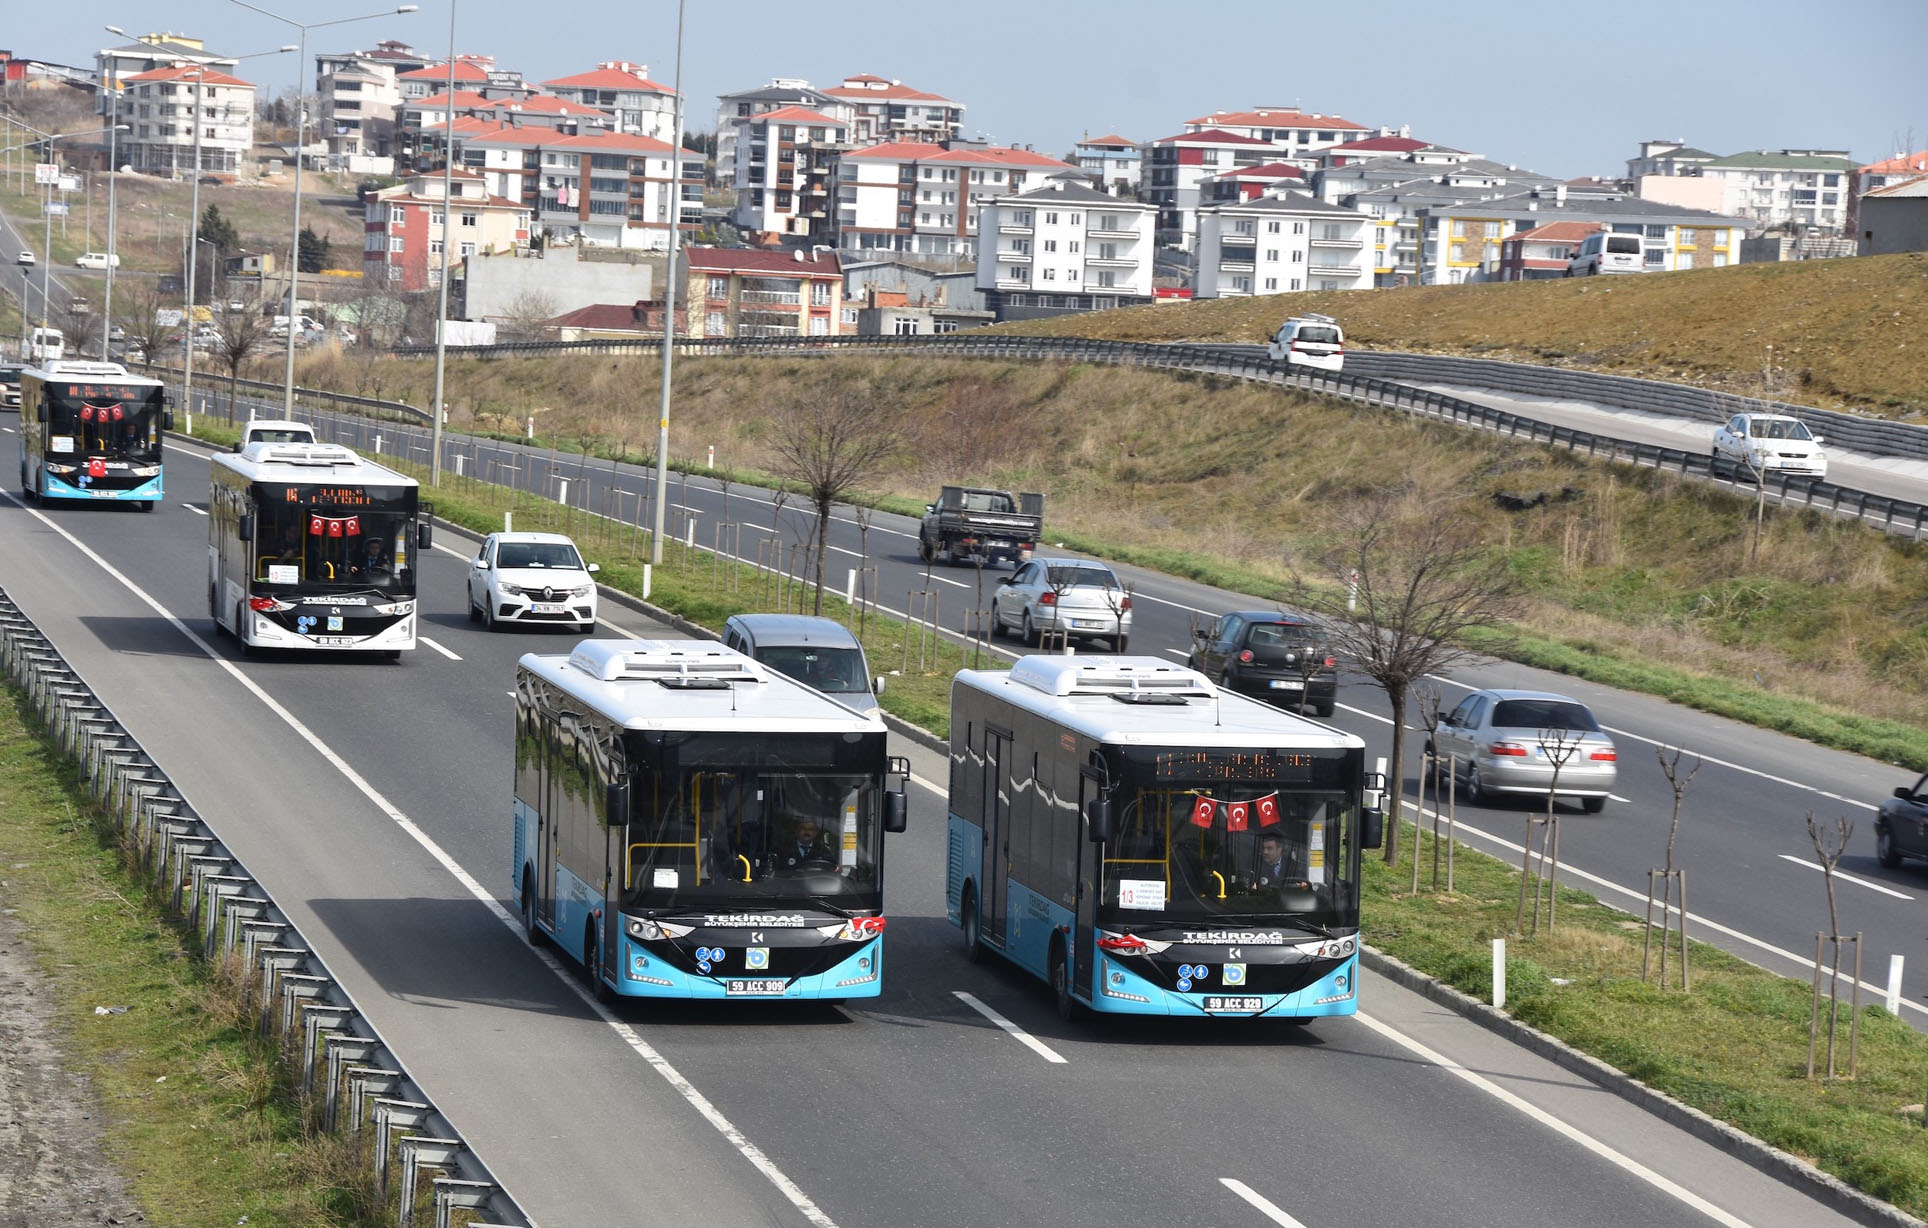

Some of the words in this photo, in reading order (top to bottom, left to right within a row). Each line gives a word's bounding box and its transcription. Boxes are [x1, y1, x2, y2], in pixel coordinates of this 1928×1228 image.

[704, 914, 804, 922] TEKİRDAĞ
[1183, 931, 1283, 940] TEKİRDAĞ
[732, 981, 744, 991] 59
[747, 981, 764, 991] ACC
[766, 981, 783, 991] 909
[1210, 998, 1222, 1008] 59
[1224, 998, 1241, 1008] ACC
